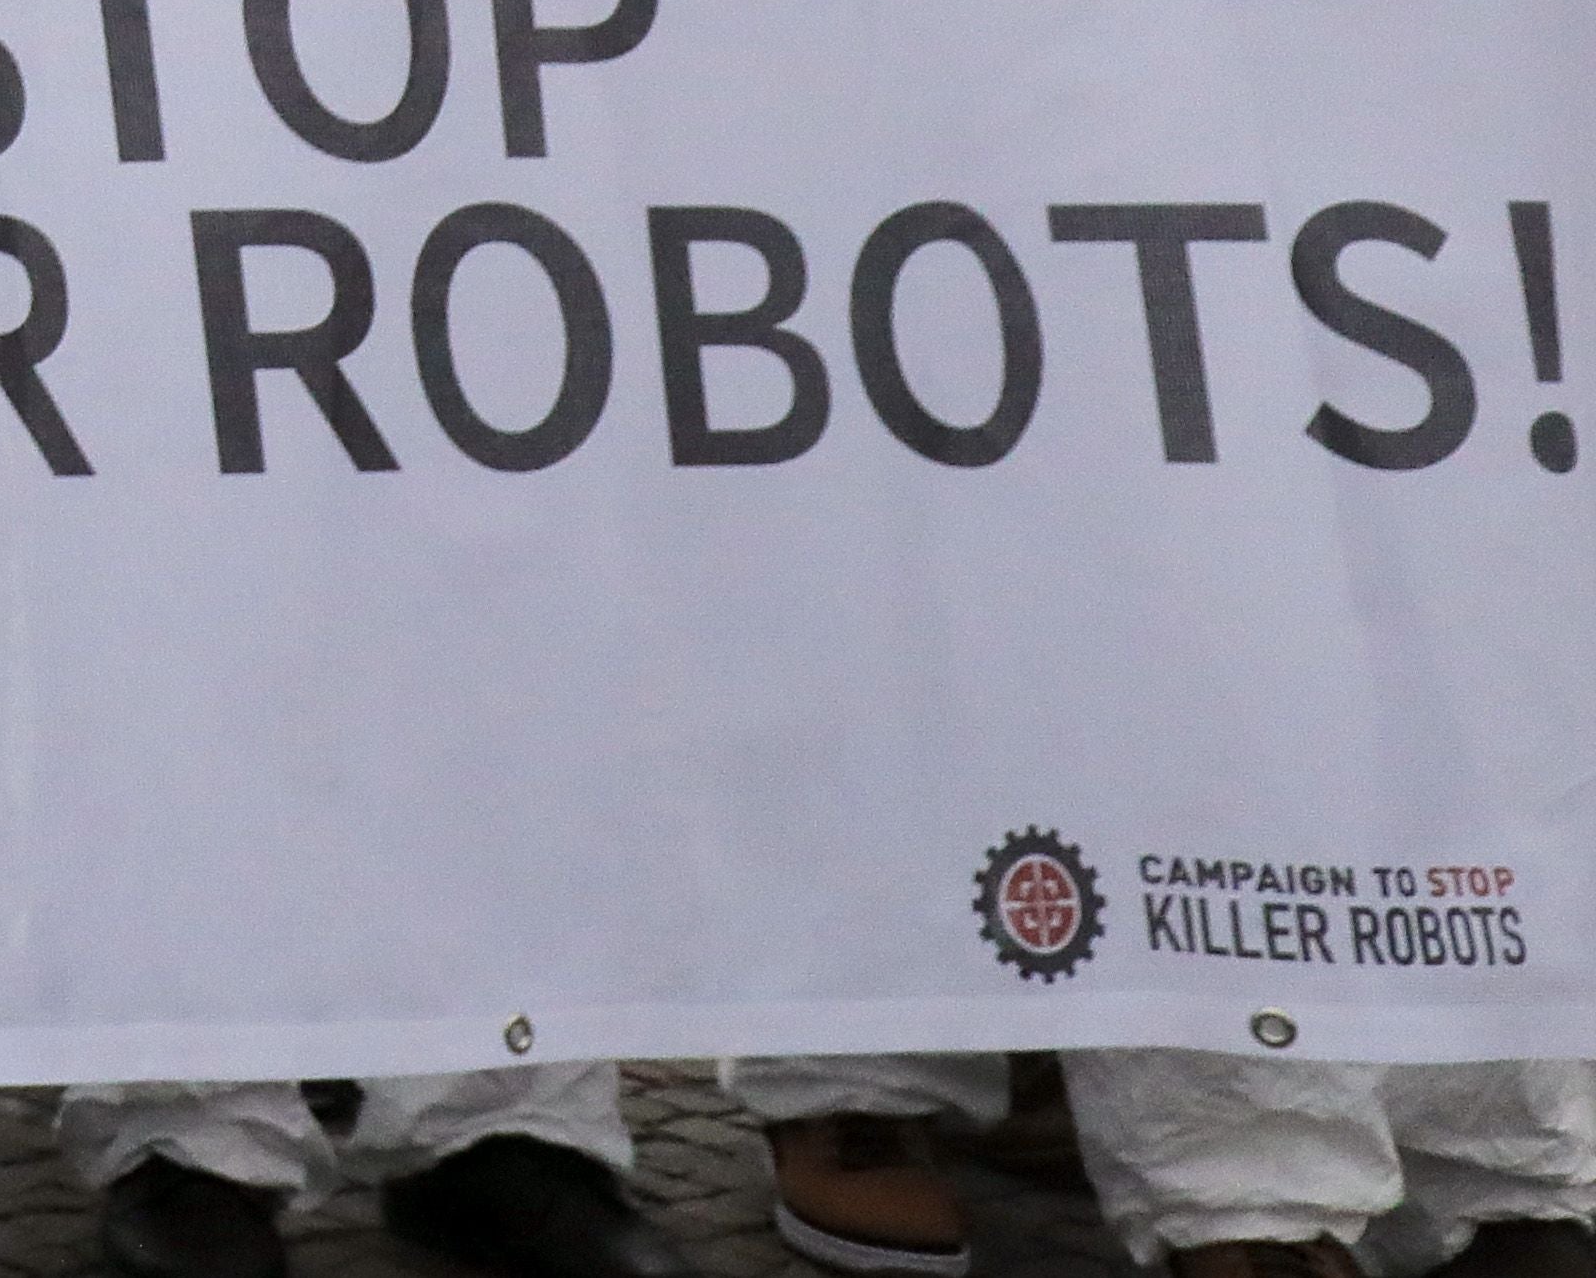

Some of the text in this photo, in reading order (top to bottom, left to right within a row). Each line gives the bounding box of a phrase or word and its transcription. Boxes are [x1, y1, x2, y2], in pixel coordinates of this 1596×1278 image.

[189, 200, 1579, 475] ROBOTS!
[1138, 853, 1516, 898] CAMPAIGN TO STOP
[1143, 893, 1527, 967] KILLER ROBOTS
